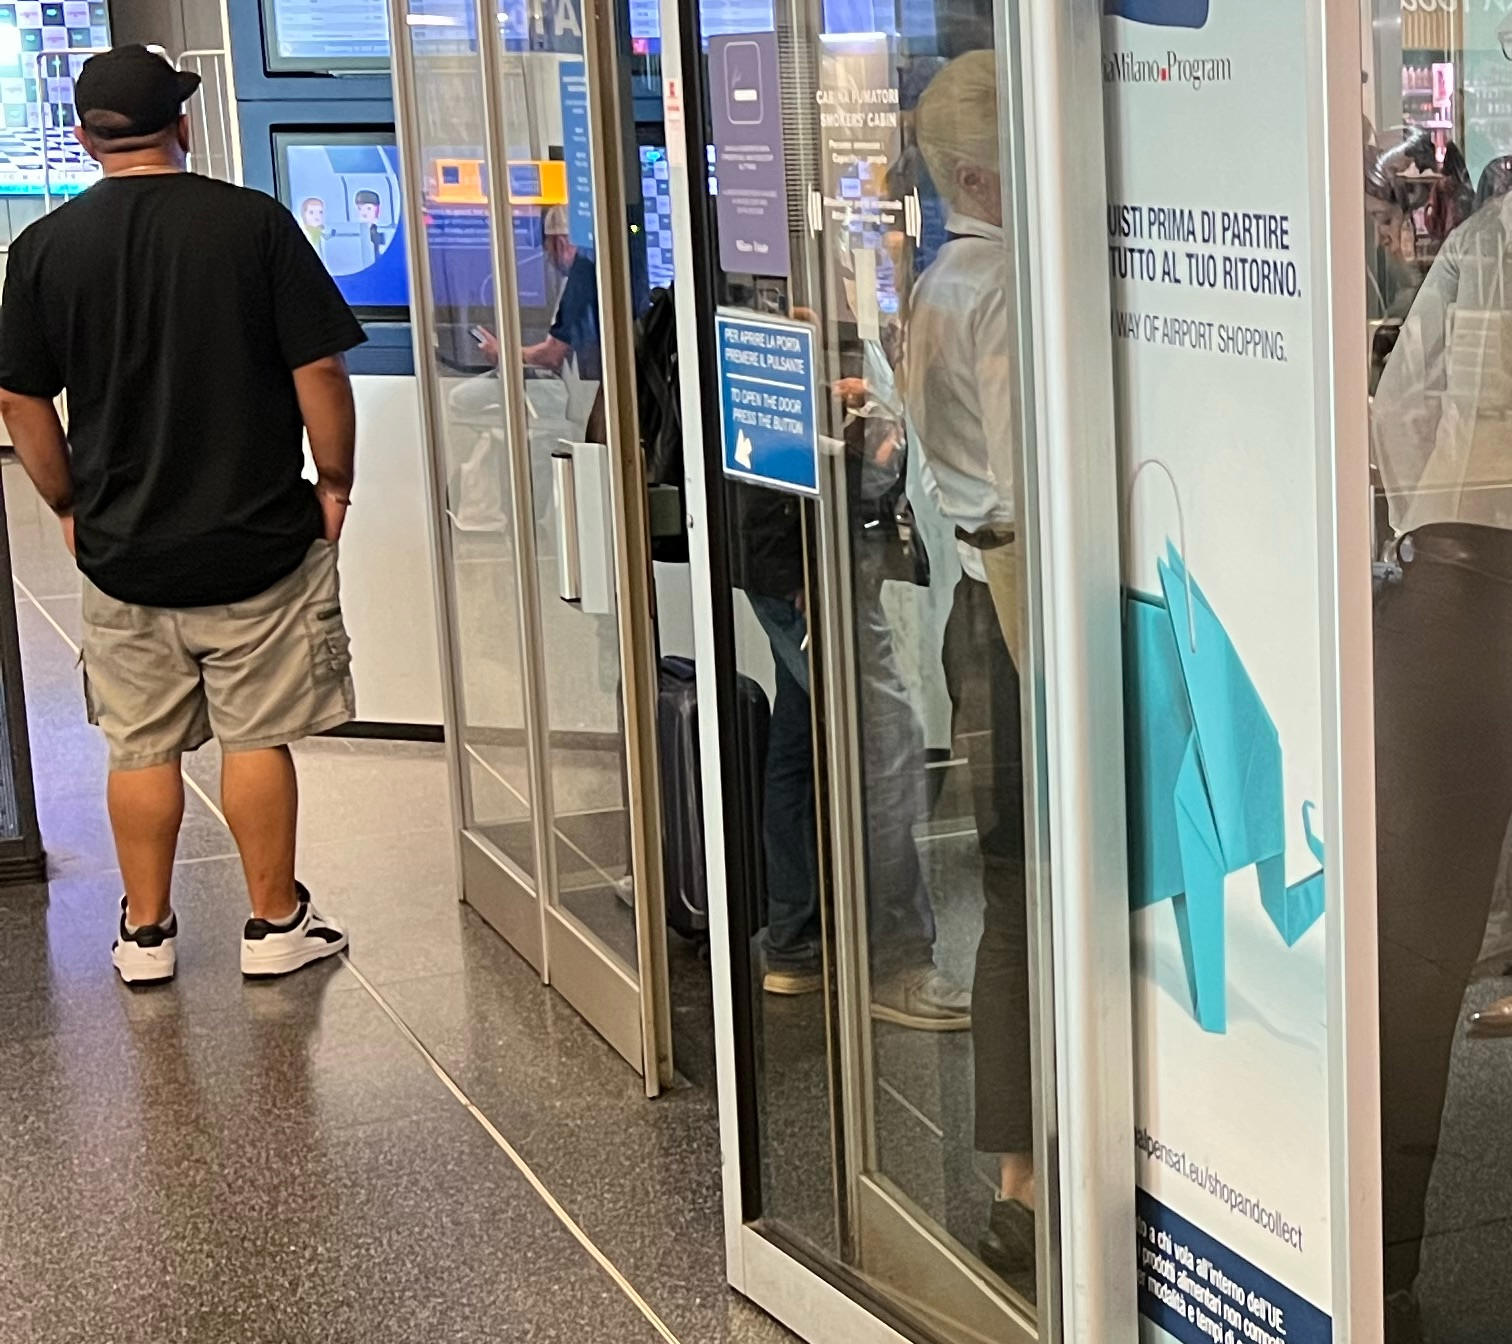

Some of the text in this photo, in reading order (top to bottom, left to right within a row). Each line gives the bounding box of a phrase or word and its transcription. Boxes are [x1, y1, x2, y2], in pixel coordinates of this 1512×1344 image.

[1167, 50, 1232, 92] Program
[867, 112, 897, 127] CABIN
[1148, 206, 1197, 244] PRIMA
[1202, 210, 1217, 245] DI
[1222, 211, 1290, 250] PARTIRE
[1109, 245, 1301, 298] TUTTO AL TUO RITORNO.
[766, 334, 777, 348] LA
[1144, 313, 1160, 343] OF
[1162, 317, 1214, 351] AIRPORT
[1218, 323, 1288, 362] SHOPPING.
[767, 354, 805, 374] PULSANTE
[730, 387, 802, 414] TO OPEN THE DOOR
[1157, 1229, 1172, 1256] chi
[1174, 1240, 1195, 1272] vola
[1196, 1256, 1246, 1307] all'interno
[1147, 1275, 1186, 1318] modalità
[1187, 1304, 1195, 1324] e
[1196, 1307, 1223, 1344] tempi
[1177, 1270, 1221, 1317] alimentari
[1223, 1303, 1242, 1331] non
